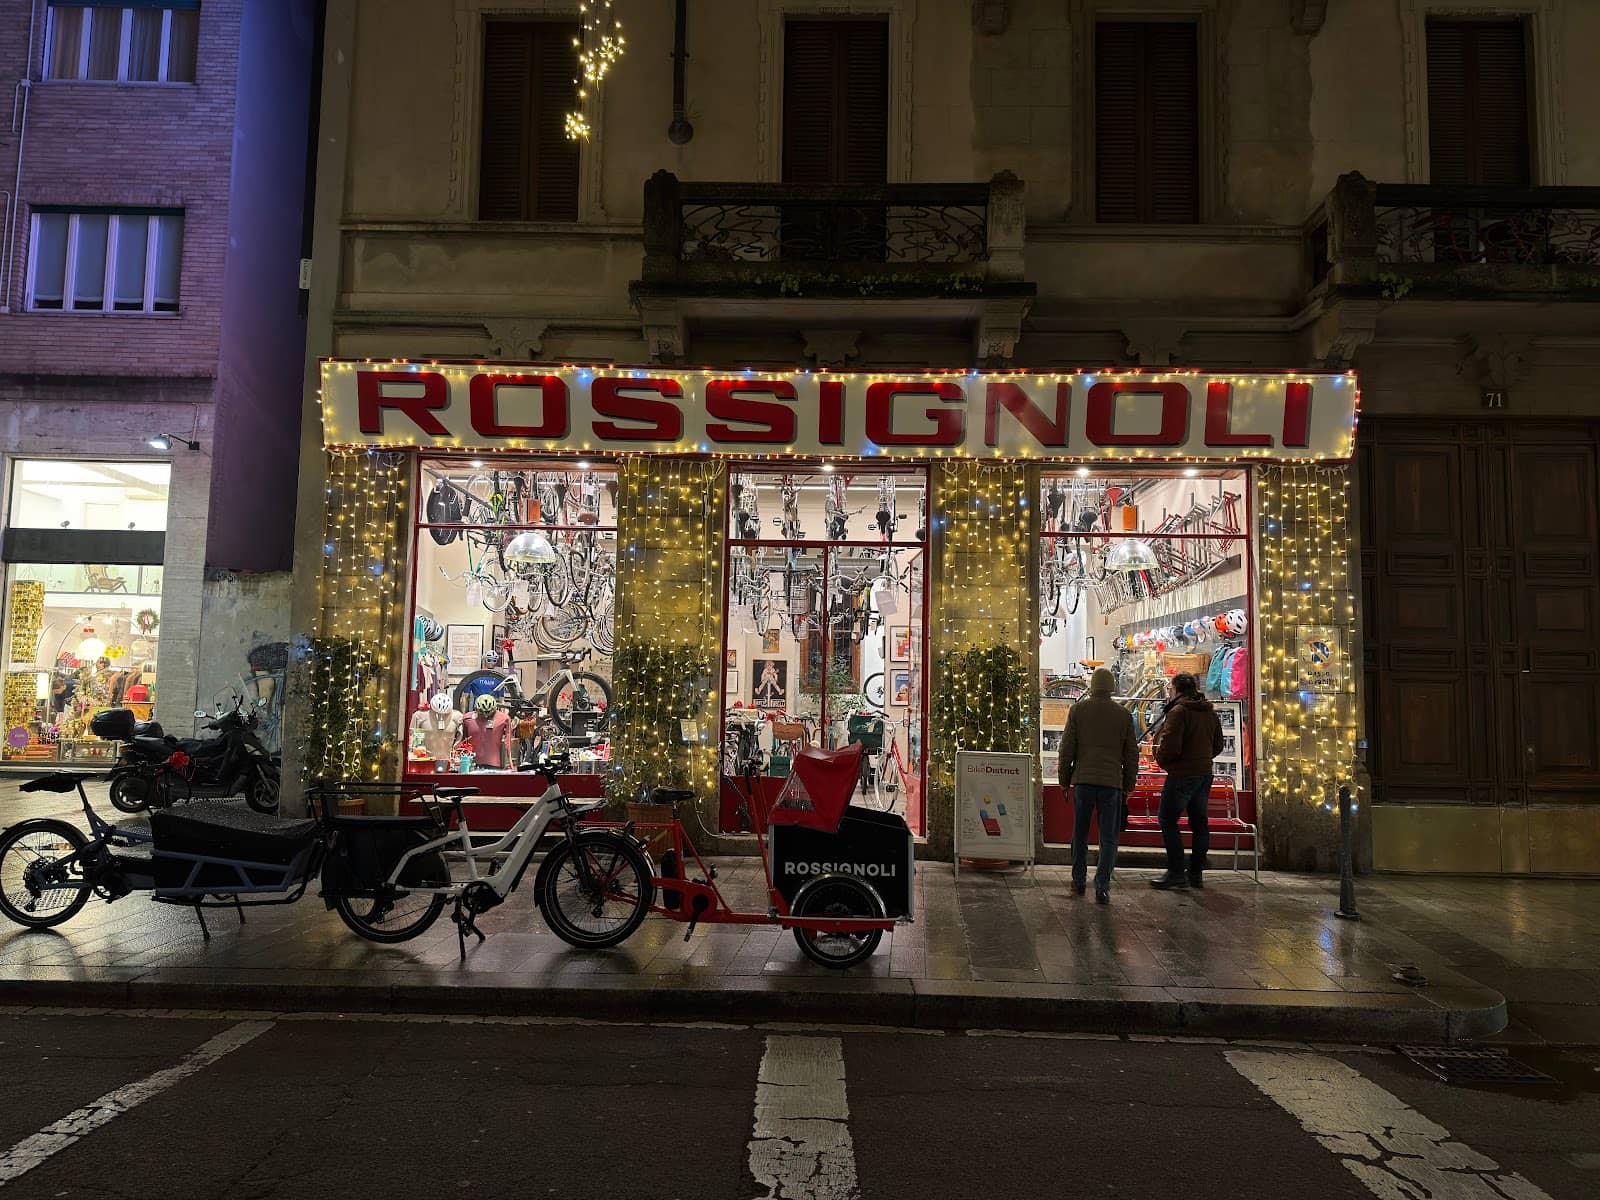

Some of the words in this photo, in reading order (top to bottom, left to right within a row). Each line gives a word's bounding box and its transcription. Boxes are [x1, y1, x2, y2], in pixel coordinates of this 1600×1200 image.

[1486, 392, 1503, 408] 71
[357, 370, 1311, 448] ROSSIGNOLI
[784, 862, 896, 877] ROSSIGNOLI
